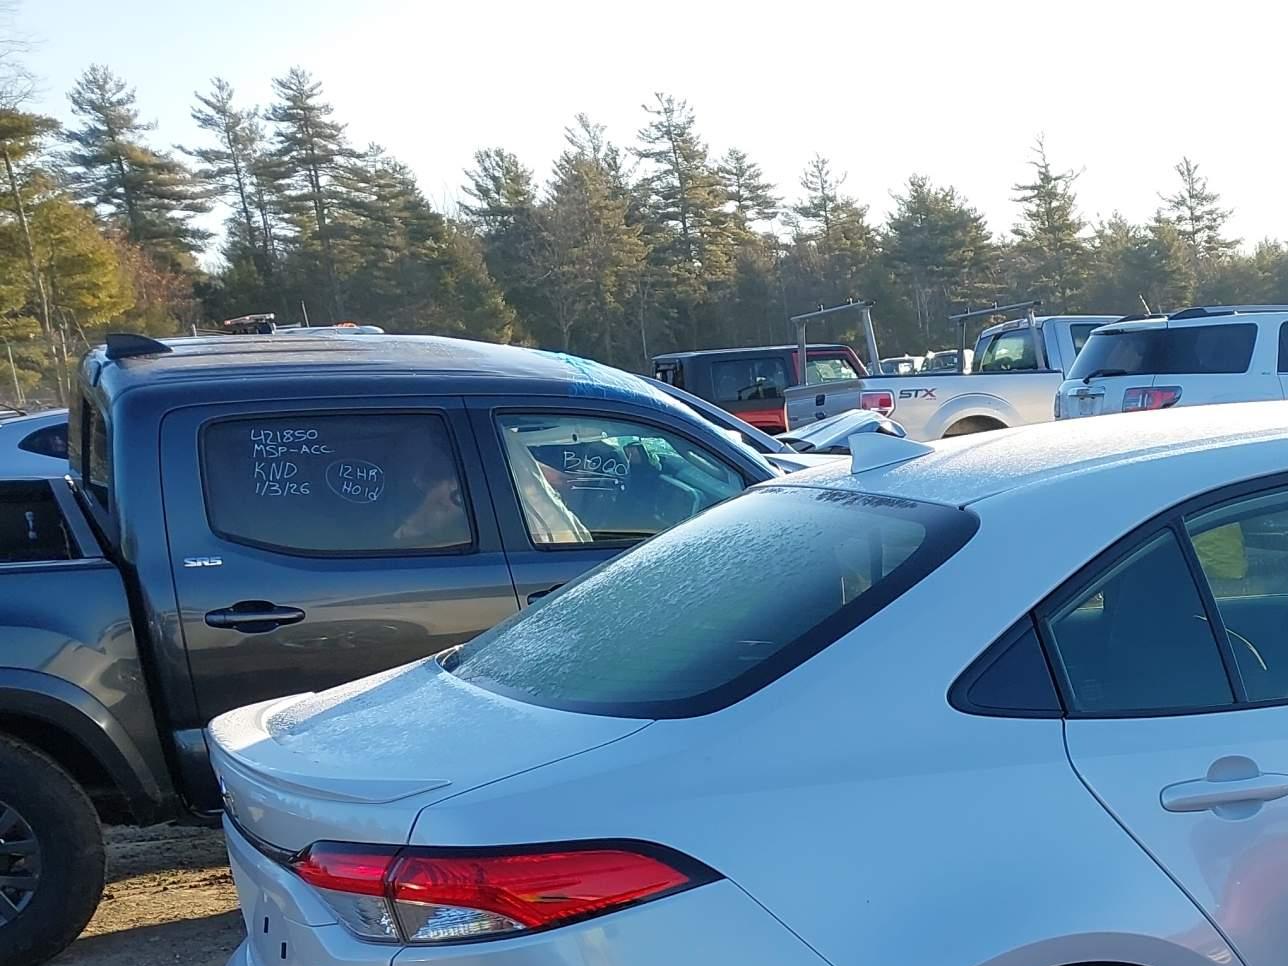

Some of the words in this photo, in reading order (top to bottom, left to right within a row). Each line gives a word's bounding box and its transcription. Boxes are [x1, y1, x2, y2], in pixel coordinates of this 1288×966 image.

[899, 387, 937, 399] STX
[250, 429, 318, 444] 421850
[254, 462, 298, 481] KND
[339, 464, 352, 478] 12
[255, 482, 311, 496] 1/3/26
